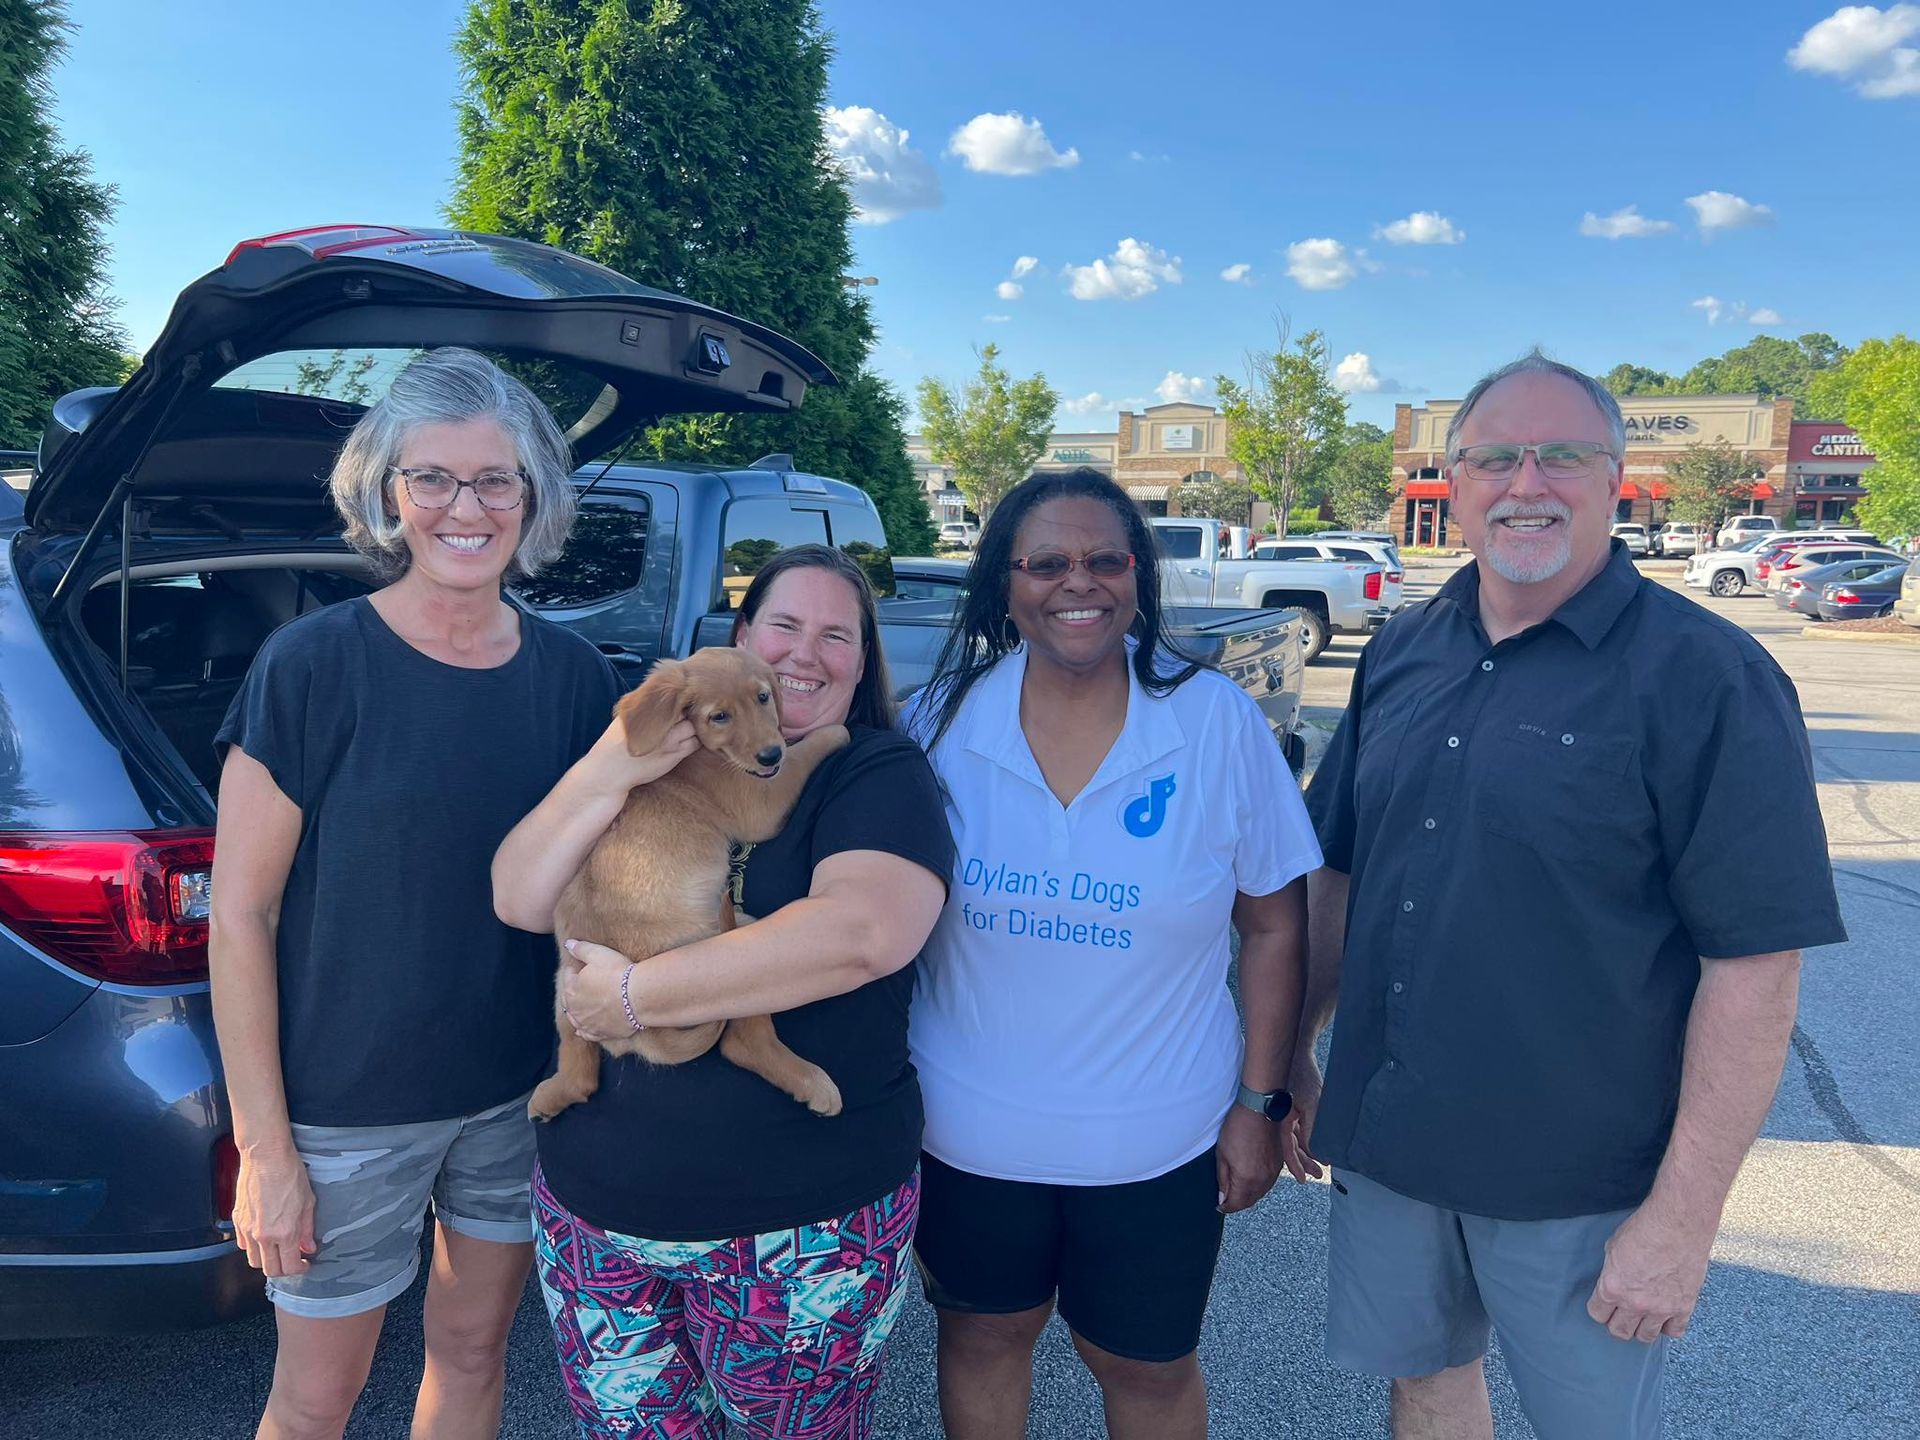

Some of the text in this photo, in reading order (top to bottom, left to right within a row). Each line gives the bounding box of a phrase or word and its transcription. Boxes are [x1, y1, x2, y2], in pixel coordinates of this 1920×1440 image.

[1625, 416, 1689, 430] AVES
[963, 858, 1141, 913] Dylan's Dogs
[962, 903, 1132, 950] for Diabetes
